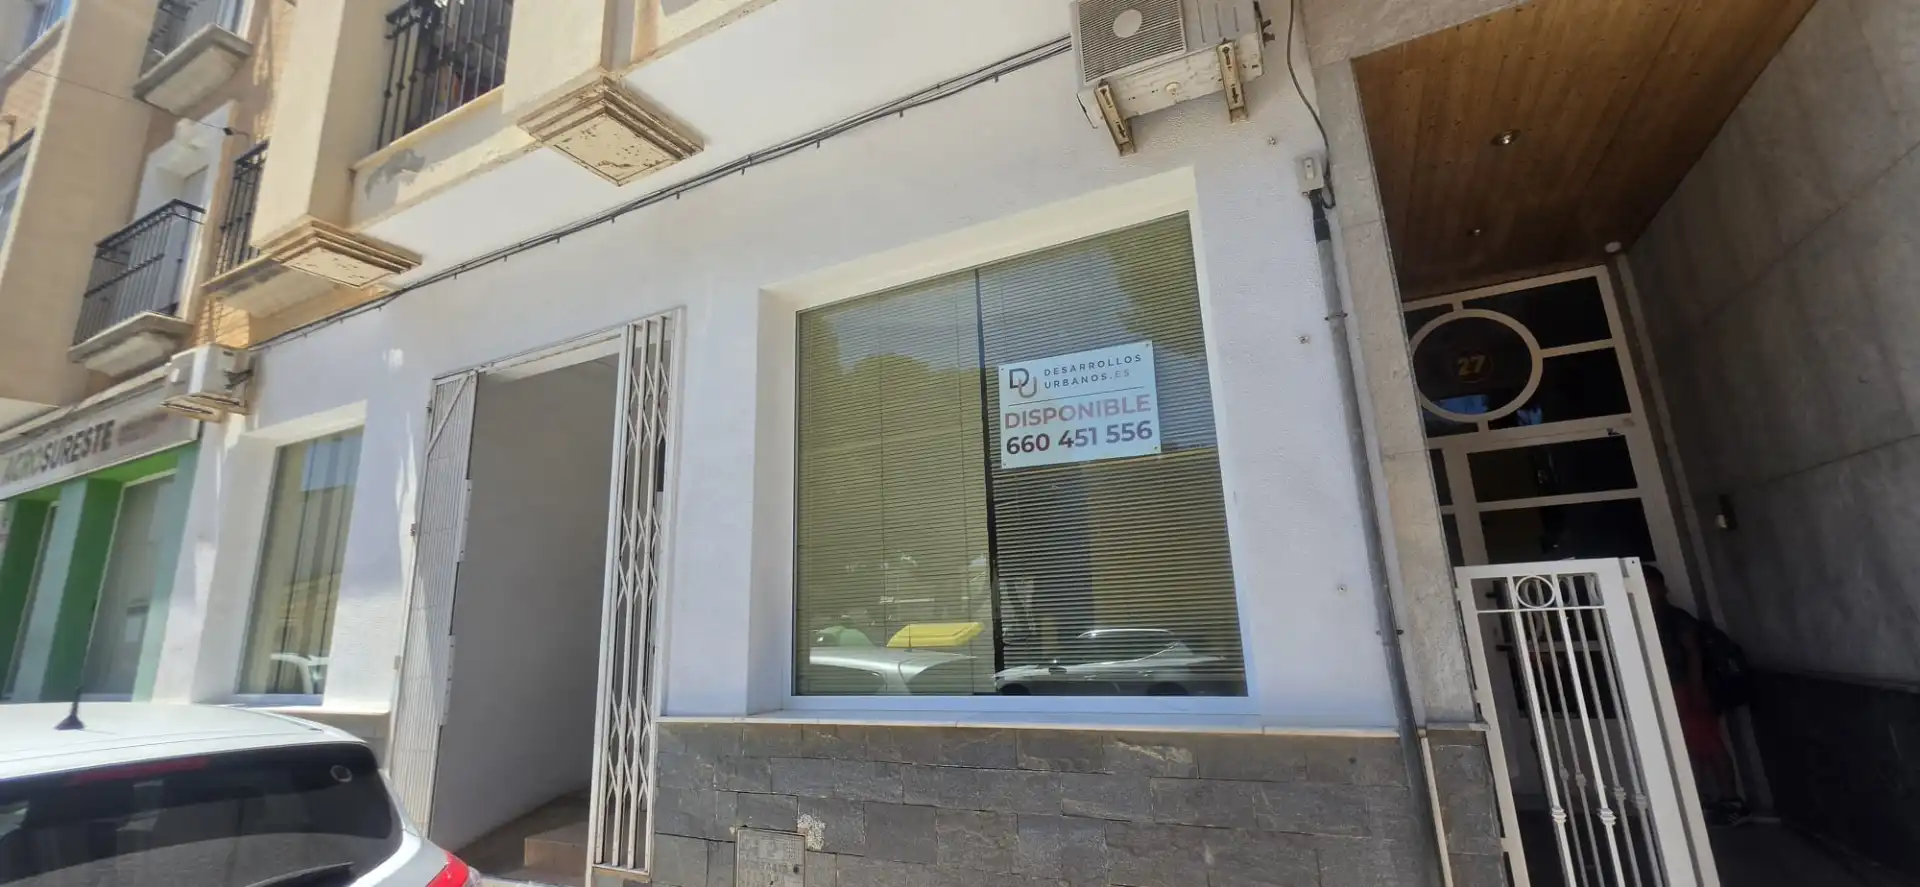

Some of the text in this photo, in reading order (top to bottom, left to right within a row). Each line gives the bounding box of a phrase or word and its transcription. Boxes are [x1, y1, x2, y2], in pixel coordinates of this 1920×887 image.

[1044, 354, 1142, 376] DESARROLLOS
[1458, 354, 1485, 375] 27
[1044, 369, 1130, 389] URBANOS.ES
[1004, 394, 1151, 429] DISPONIBLE
[1006, 420, 1153, 455] 660 451 556
